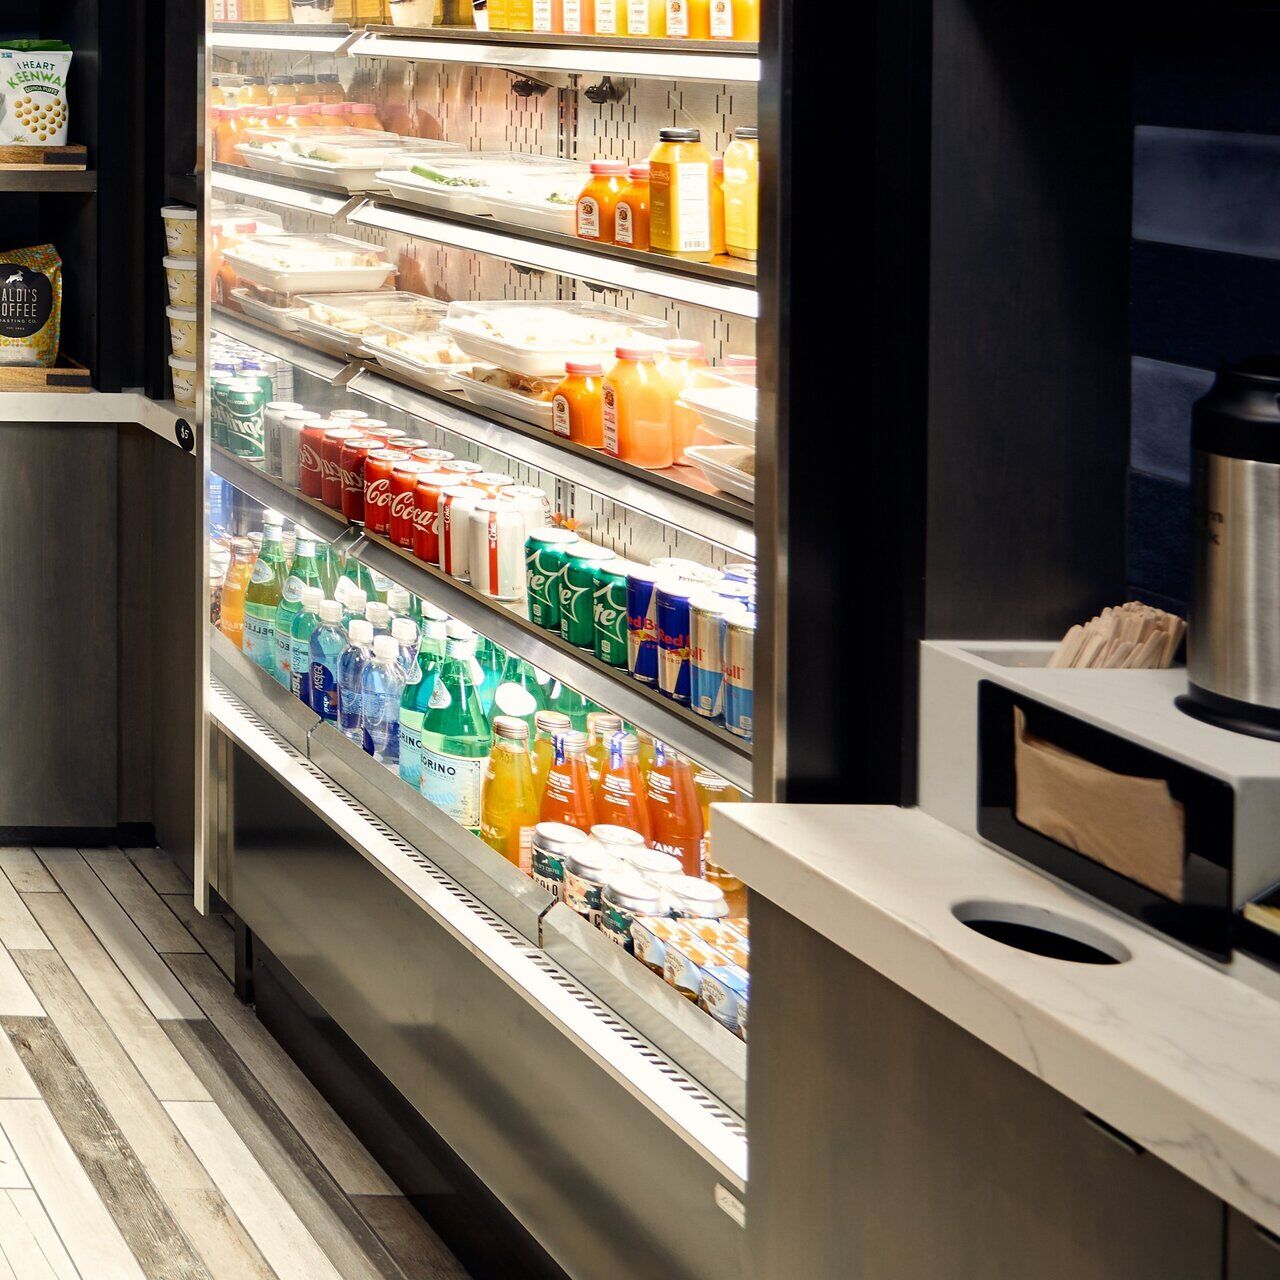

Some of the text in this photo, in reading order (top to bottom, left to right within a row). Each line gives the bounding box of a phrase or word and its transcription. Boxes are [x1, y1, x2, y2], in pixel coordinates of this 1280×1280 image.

[23, 61, 55, 70] HEART
[7, 71, 67, 88] KEENWA
[181, 425, 189, 439] $5
